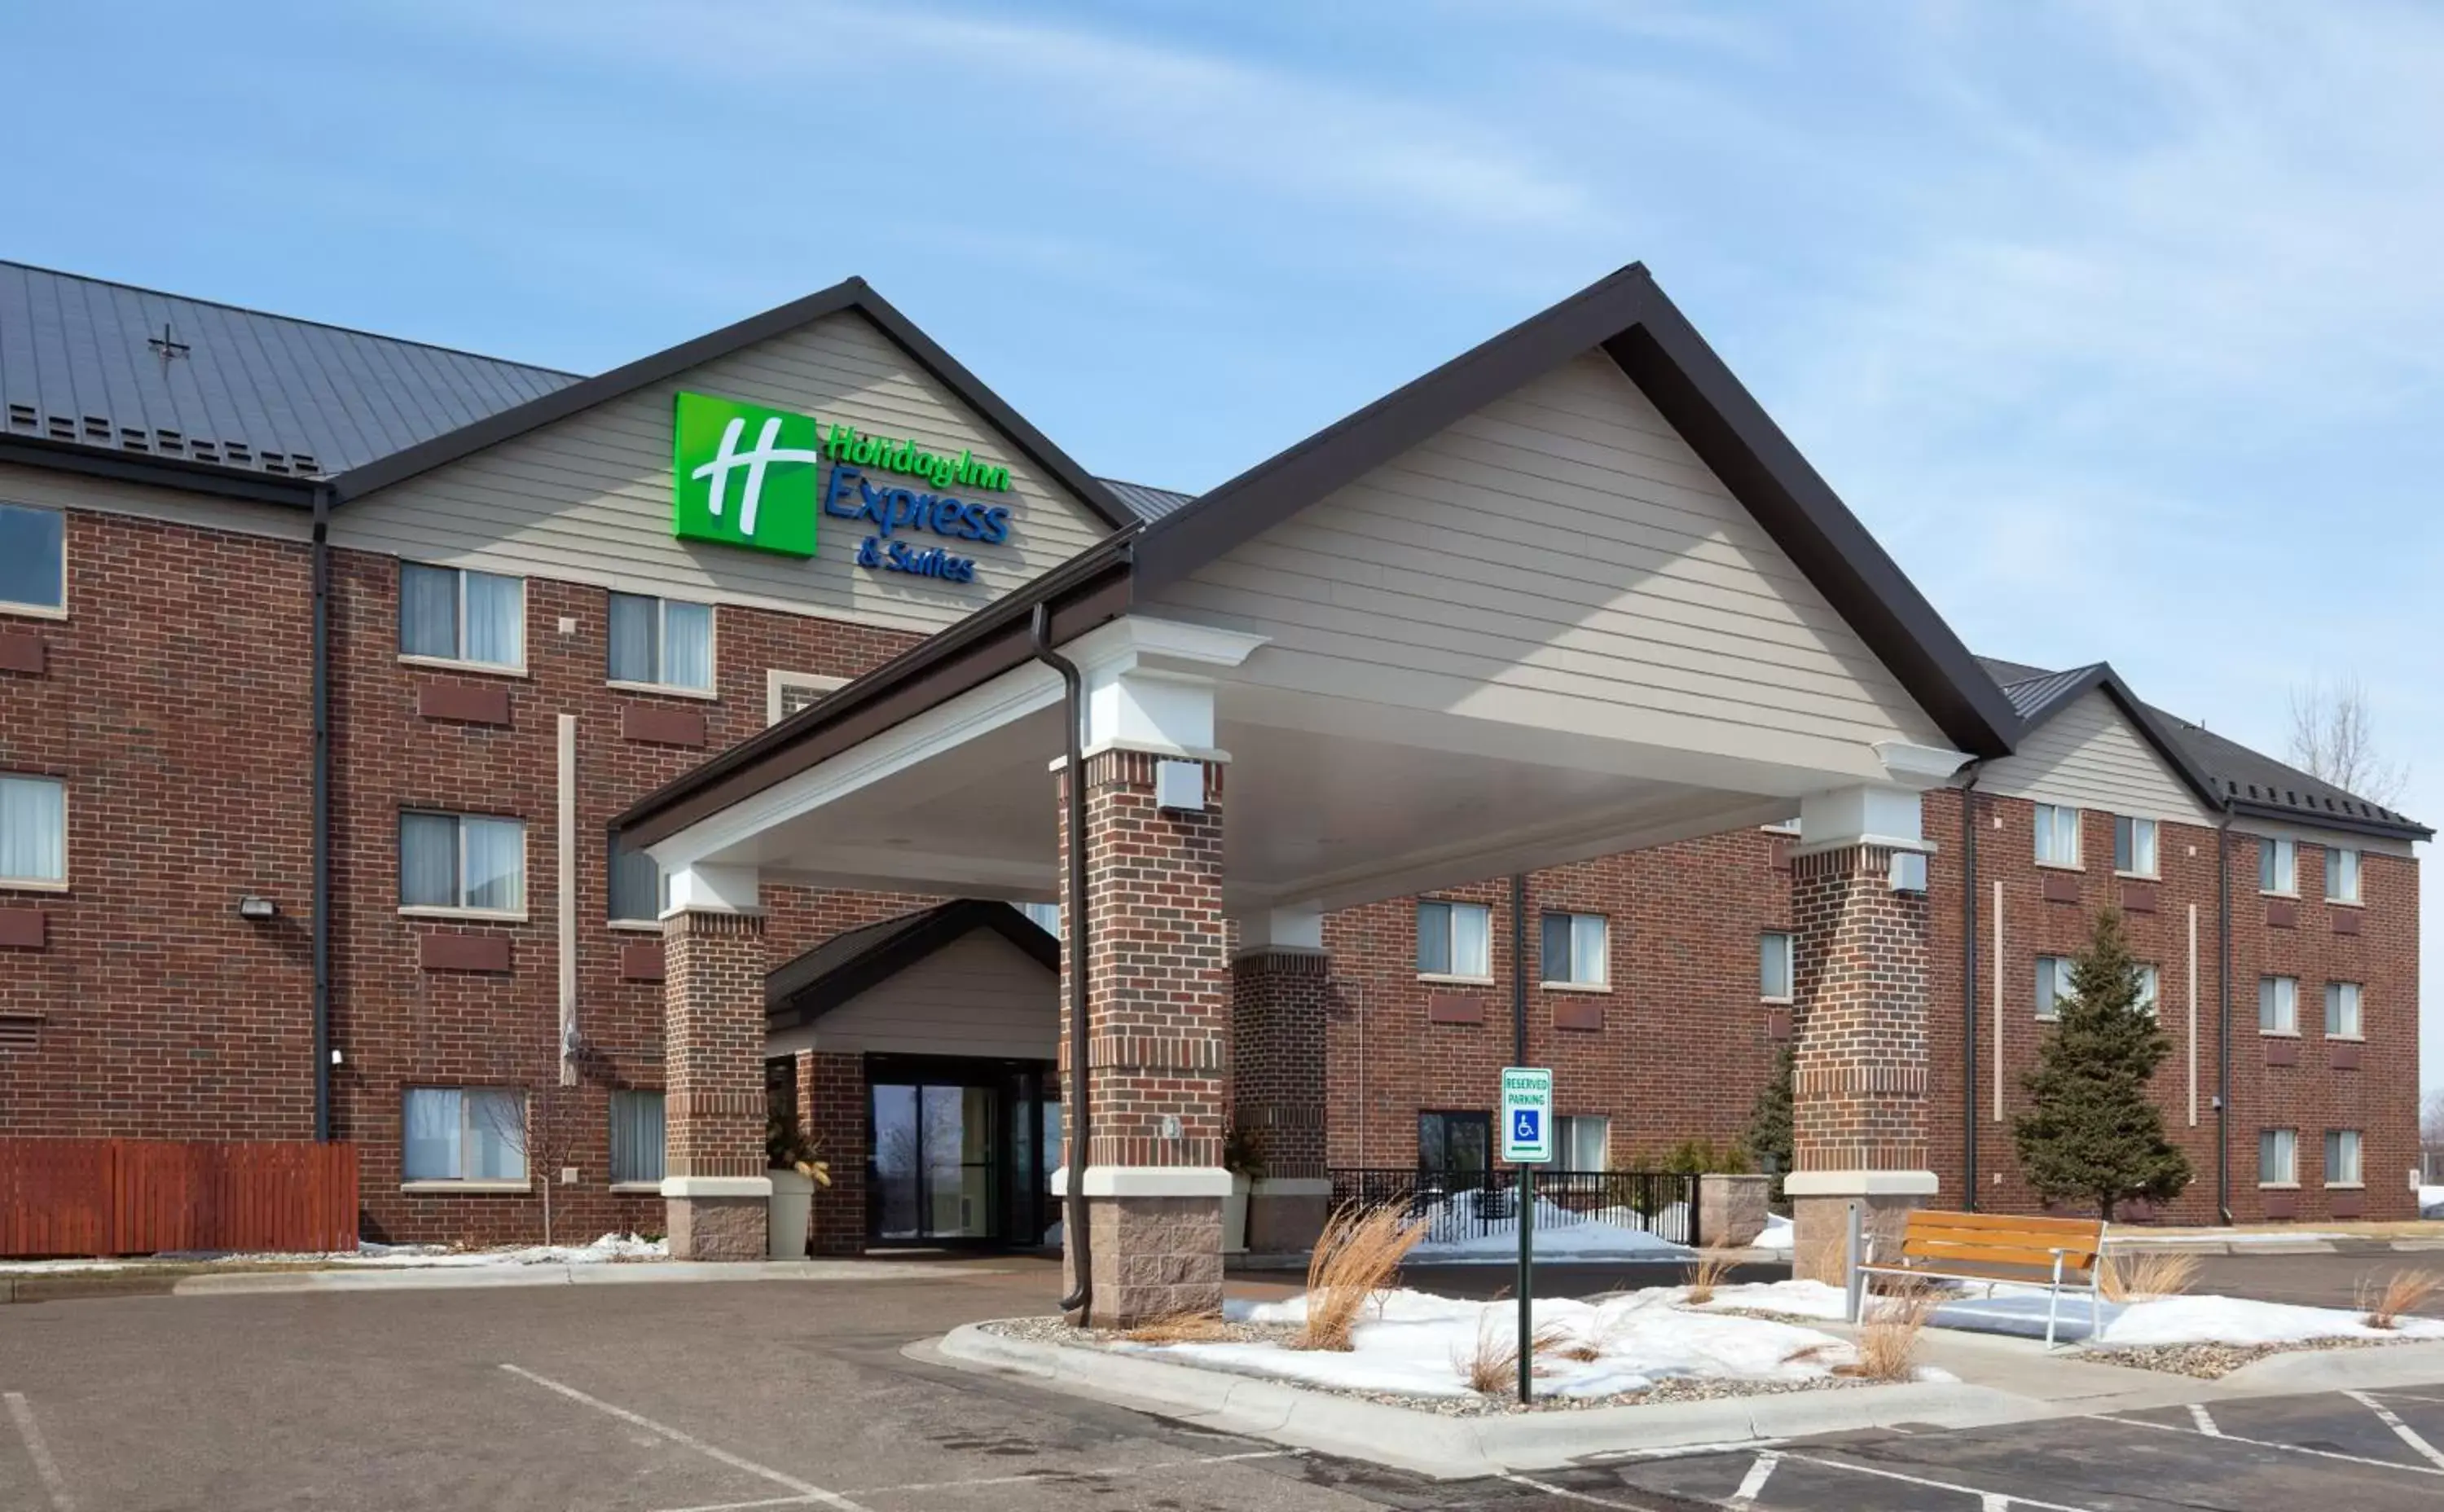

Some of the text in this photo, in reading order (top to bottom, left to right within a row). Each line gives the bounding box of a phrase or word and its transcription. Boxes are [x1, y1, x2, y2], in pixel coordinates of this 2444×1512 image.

[825, 423, 1010, 492] Holiday Inn
[824, 465, 1010, 545] Express
[858, 535, 976, 582] & Suites
[1506, 1078, 1547, 1090] RESERVED
[1508, 1094, 1545, 1105] PARKING
